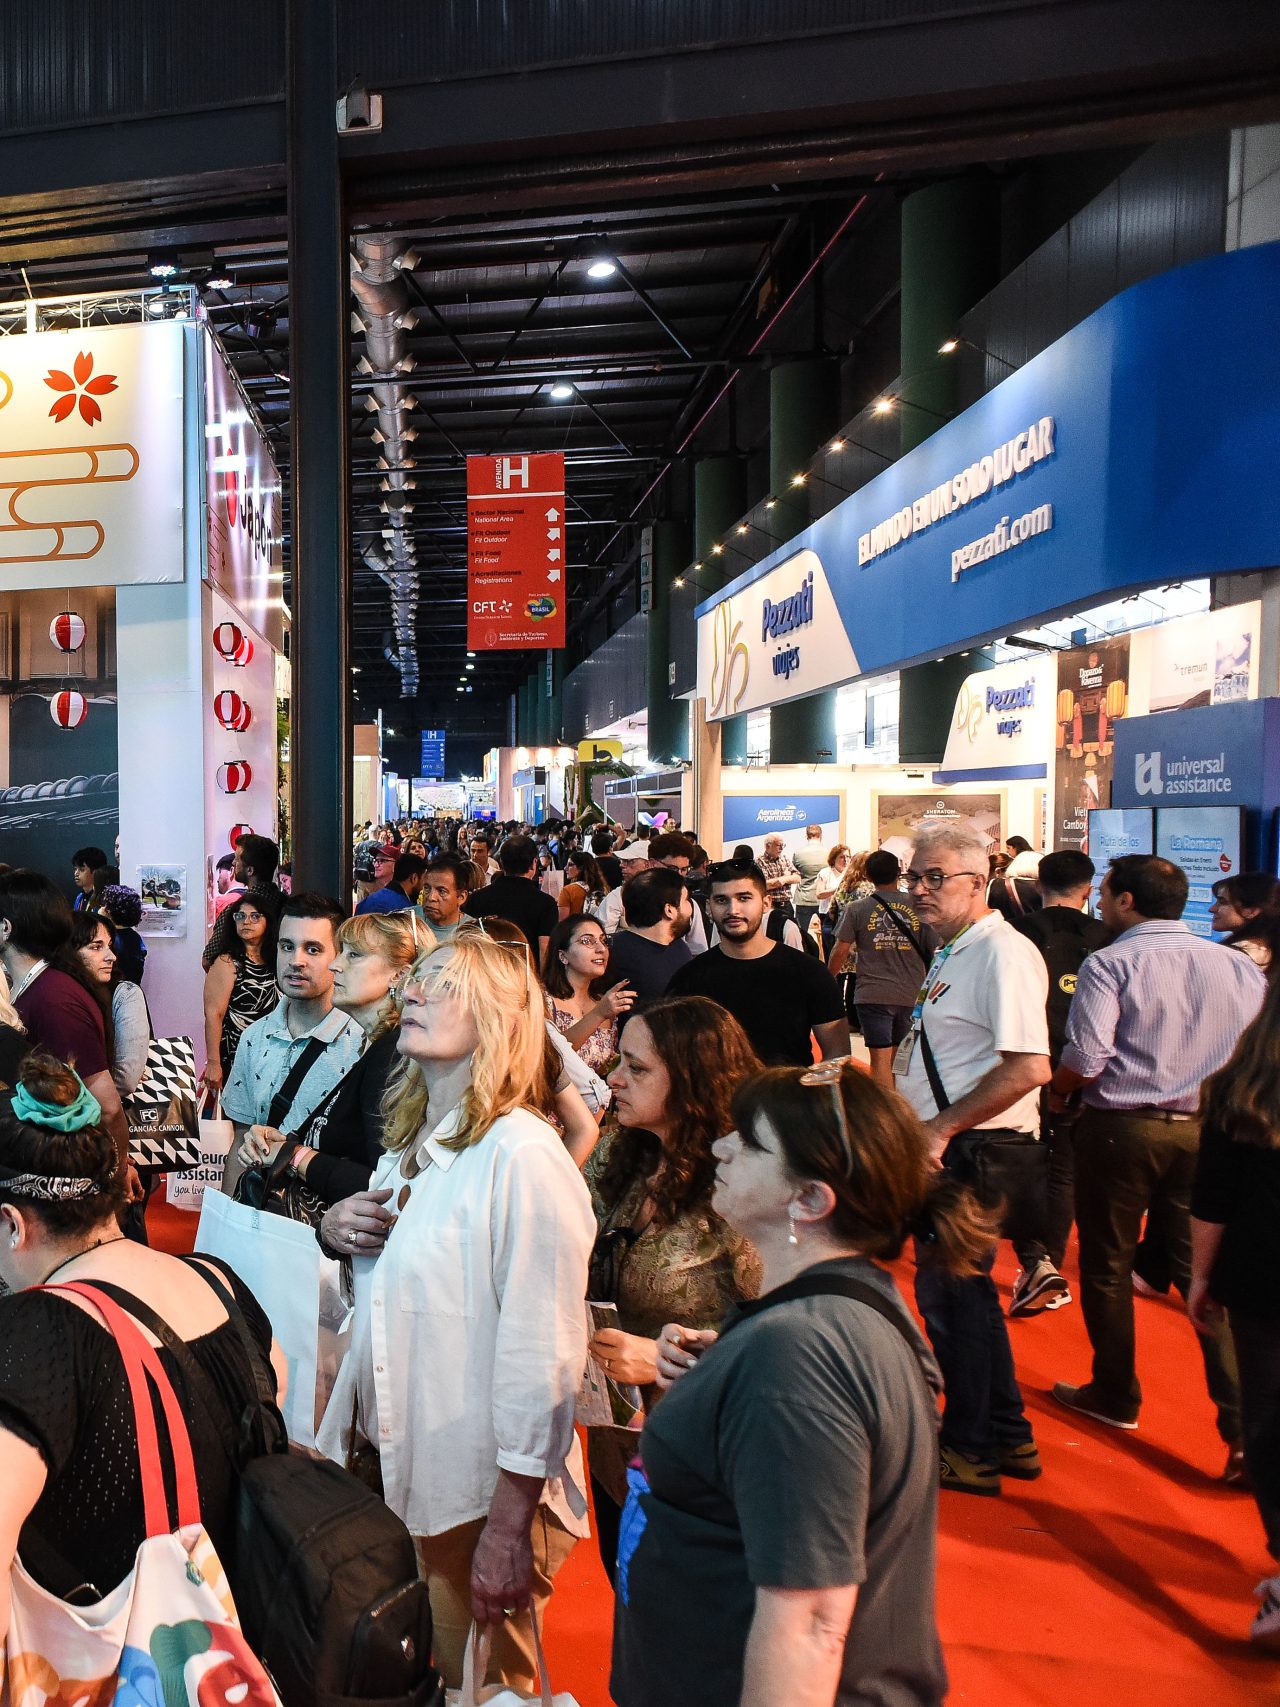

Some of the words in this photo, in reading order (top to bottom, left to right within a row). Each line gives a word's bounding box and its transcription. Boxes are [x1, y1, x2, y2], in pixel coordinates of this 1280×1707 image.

[993, 416, 1056, 487] LUGAR
[502, 457, 529, 489] H
[951, 503, 1053, 583] pezzati.com
[473, 601, 497, 613] CFT
[761, 570, 814, 643] Pezzati
[772, 642, 800, 680] viajes
[985, 676, 1036, 714] Pezzati
[1166, 752, 1225, 777] universal
[1166, 774, 1232, 795] assistance
[875, 902, 920, 932] Bginnings
[128, 1124, 157, 1133] GANCIAS
[158, 1124, 185, 1133] CANNON
[201, 1152, 228, 1165] euro
[176, 1168, 224, 1182] assistan
[173, 1185, 190, 1198] you
